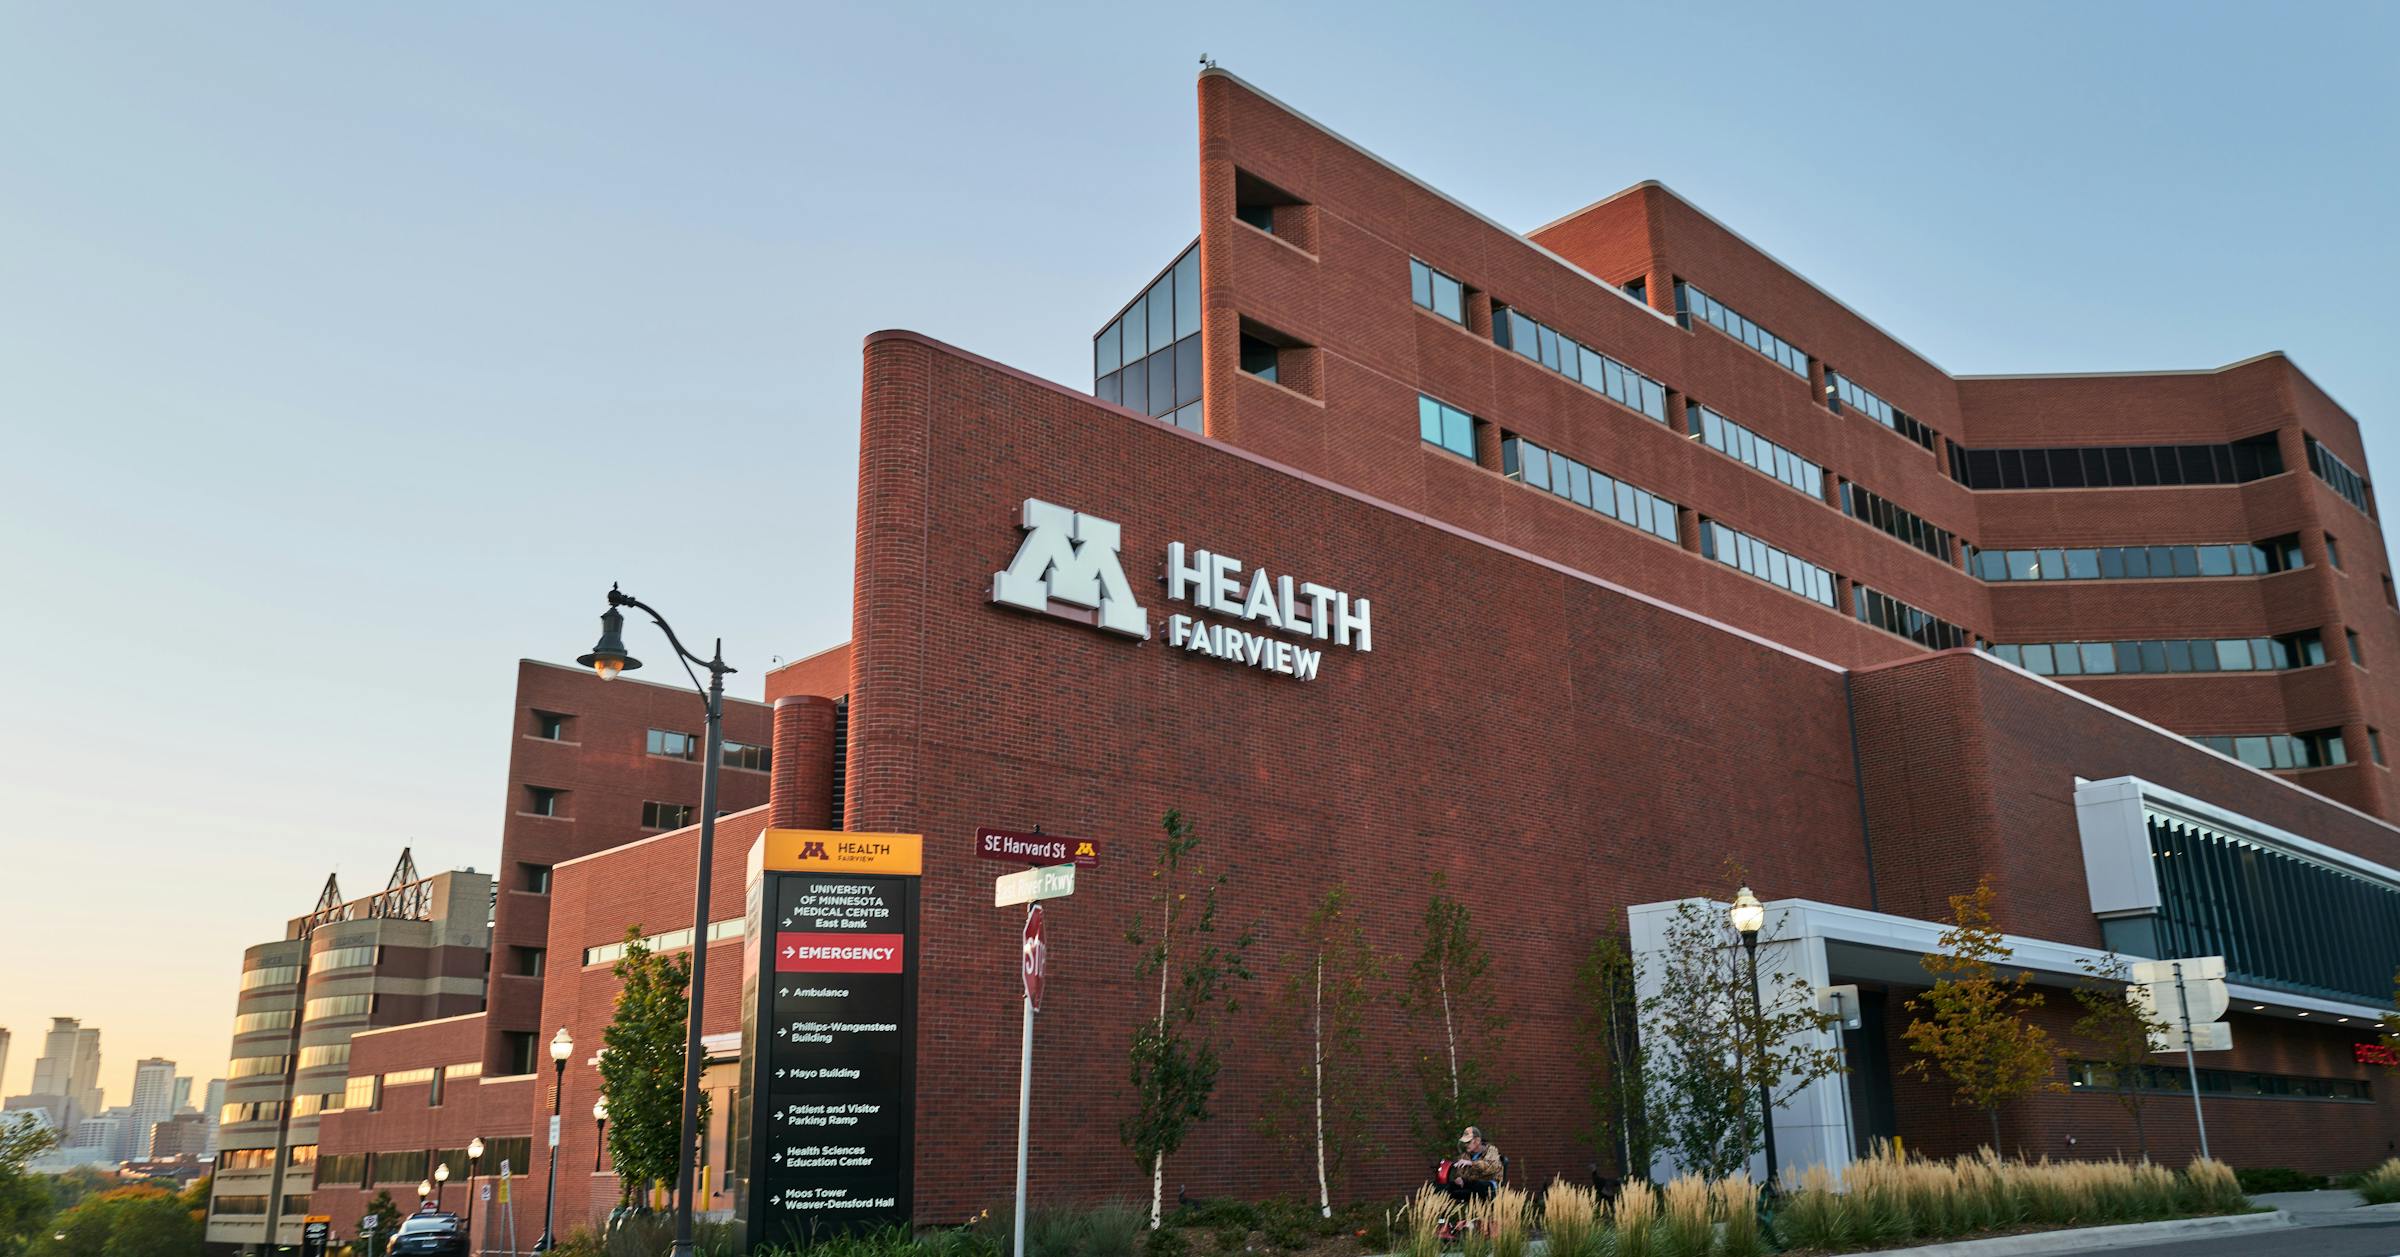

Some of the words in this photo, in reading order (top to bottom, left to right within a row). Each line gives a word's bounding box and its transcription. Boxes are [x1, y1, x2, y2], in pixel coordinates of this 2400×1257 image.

[993, 497, 1149, 640] M
[1167, 541, 1372, 651] HEALTH
[1168, 613, 1321, 681] FAIRVIEW
[838, 843, 890, 855] HEALTH
[985, 835, 1001, 851] SE
[1003, 837, 1051, 857] Harvard
[1052, 842, 1066, 859] St
[1045, 873, 1073, 893] Pkwy
[810, 884, 875, 895] UNIVERSITY
[800, 895, 817, 905] OF
[818, 896, 884, 906] MINNESOTA
[794, 907, 843, 916] MEDICAL
[845, 908, 889, 918] CENTER
[815, 918, 838, 928] East
[840, 918, 867, 929] Bank
[798, 947, 895, 960] EMERGENCY
[793, 988, 849, 997] Ambulance
[792, 1022, 897, 1033] Phillips-Wangensteen
[791, 1033, 833, 1044] Building
[790, 1068, 818, 1079] Mayo
[819, 1068, 860, 1079] Building
[788, 1105, 825, 1114] Patient
[826, 1104, 846, 1114] and
[847, 1104, 880, 1114] Visitor
[788, 1115, 827, 1126] Parking
[828, 1115, 858, 1126] Ramp
[787, 1146, 820, 1156] Health
[821, 1146, 865, 1155] Sciences
[786, 1157, 837, 1167] Education
[838, 1157, 873, 1167] Center
[785, 1189, 813, 1198] Moos
[814, 1188, 847, 1198] Tower
[785, 1198, 874, 1210] Weaver-Densford
[874, 1197, 895, 1208] Hall
